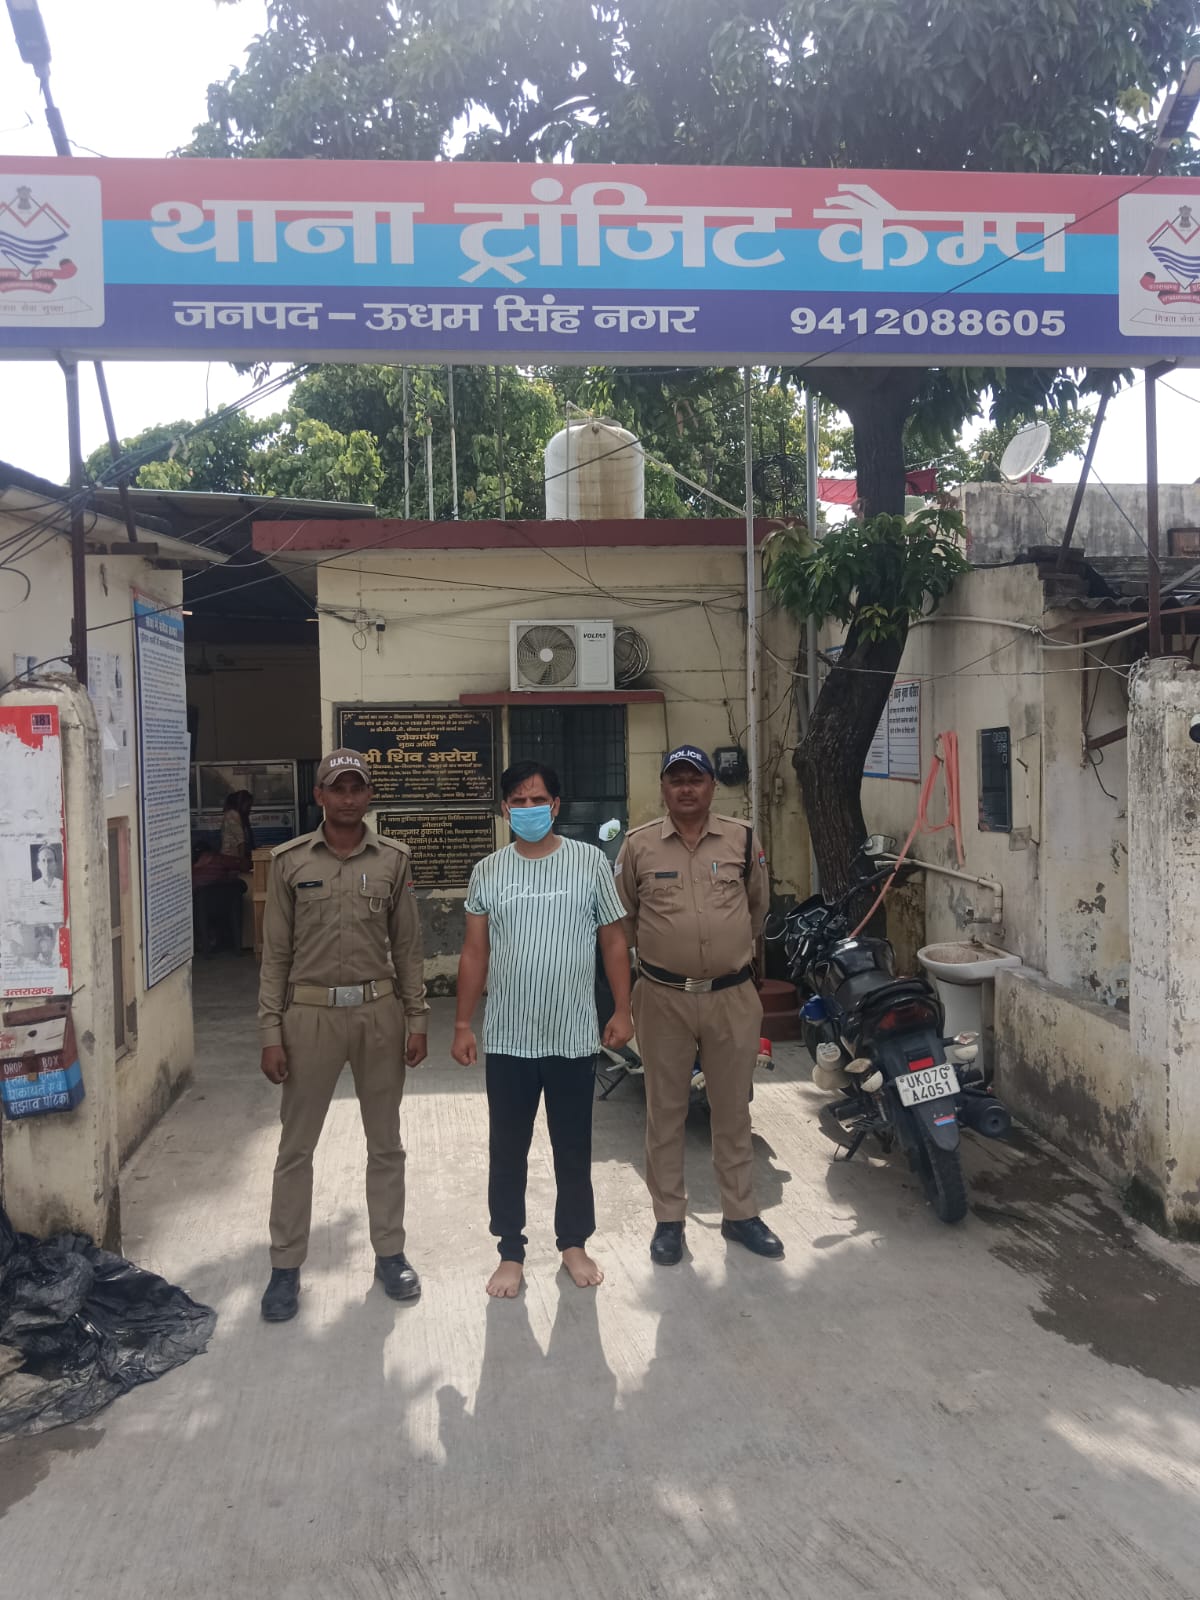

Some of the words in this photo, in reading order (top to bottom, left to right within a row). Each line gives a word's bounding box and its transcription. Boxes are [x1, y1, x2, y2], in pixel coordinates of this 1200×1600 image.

[150, 199, 424, 264] थाना
[454, 178, 792, 284] ट्रांजिट
[813, 183, 1075, 273] कैम्प
[173, 301, 322, 331] जनपद
[364, 302, 482, 333] ऊधम
[493, 294, 584, 334] सिंह
[592, 305, 700, 334] नगर
[791, 306, 1066, 337] 9412088605
[396, 732, 439, 741] लोकार्पण
[386, 748, 424, 763] शिव
[427, 747, 478, 763] अरोरा
[669, 749, 703, 762] POLICE
[3, 986, 54, 996] उत्तराखण्ड
[4, 1061, 23, 1075] DROP
[41, 1055, 59, 1068] BOX
[906, 1067, 948, 1088] UK07G
[912, 1081, 952, 1102] A4051
